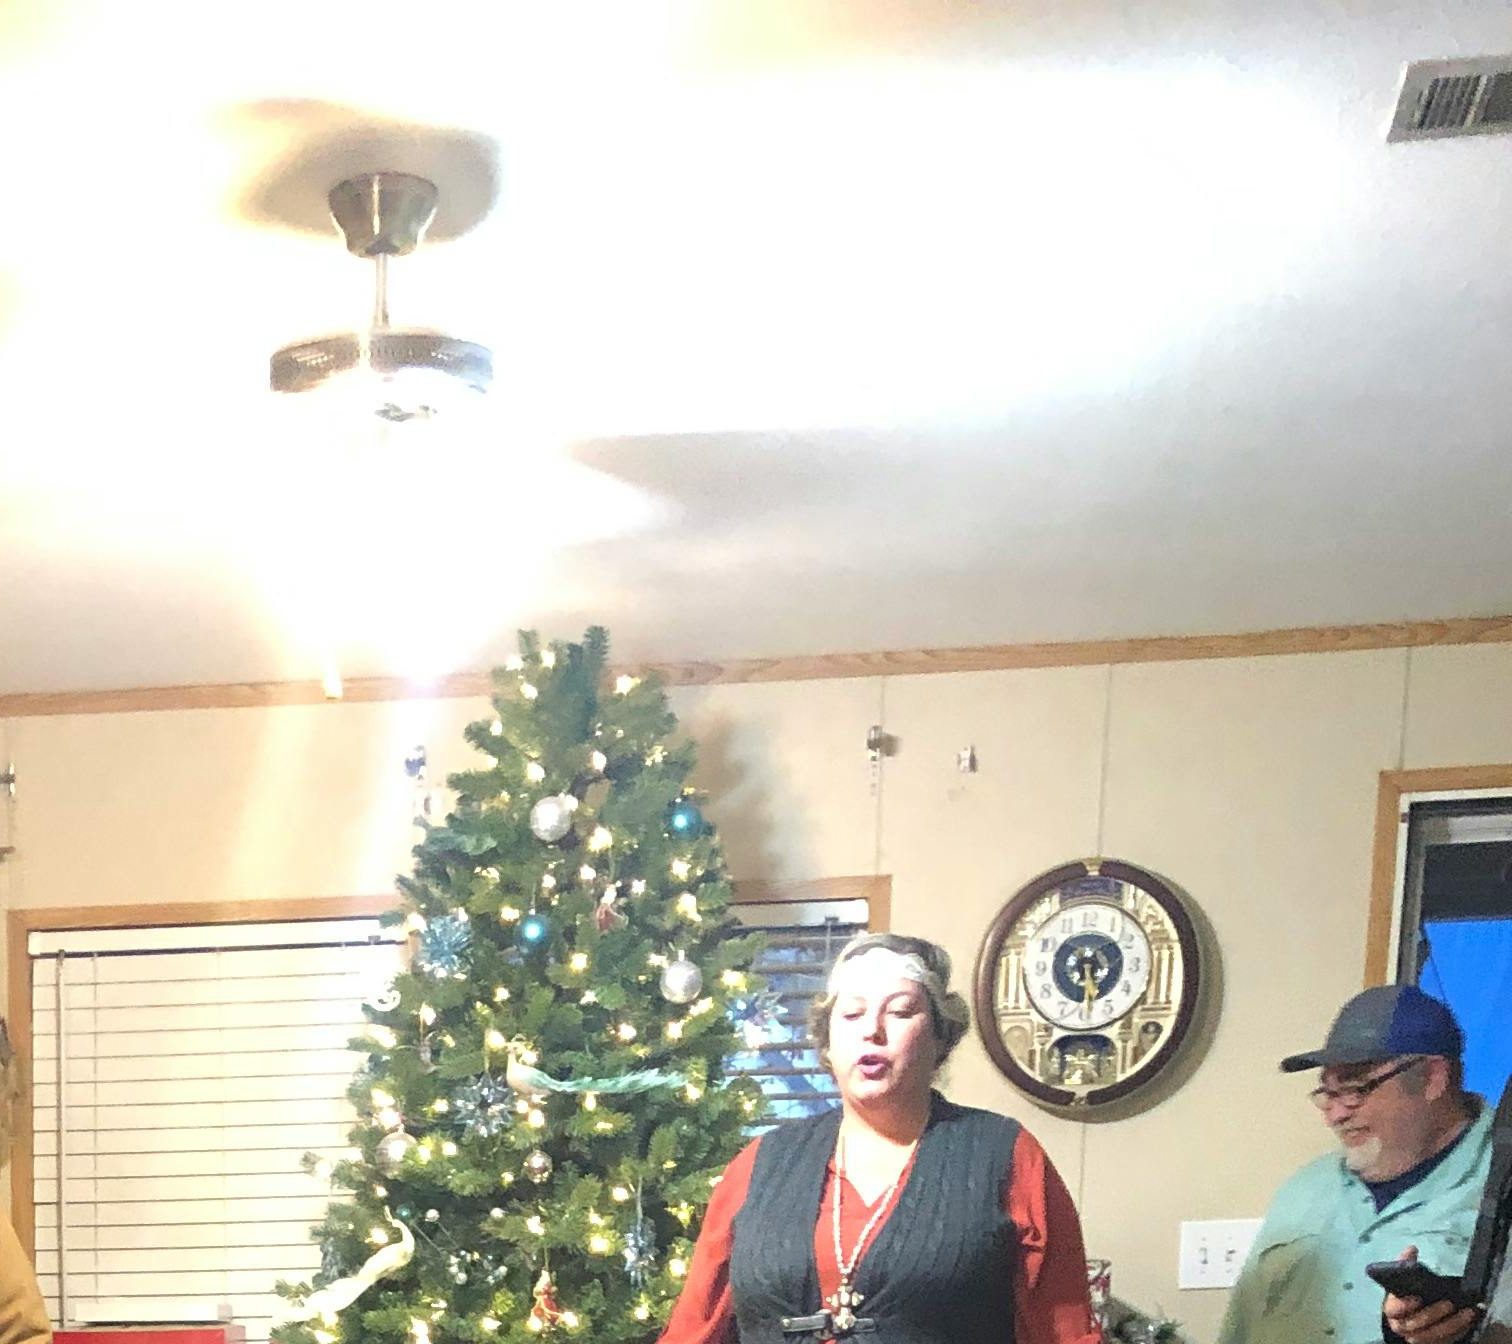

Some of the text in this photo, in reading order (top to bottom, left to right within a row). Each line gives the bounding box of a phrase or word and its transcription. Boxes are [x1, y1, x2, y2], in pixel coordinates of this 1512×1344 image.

[1062, 918, 1073, 933] 11
[1082, 911, 1098, 927] 12
[1110, 917, 1117, 932] 1
[1035, 961, 1047, 976] 9
[1128, 957, 1141, 973] 3
[1040, 983, 1052, 999] 8
[1121, 979, 1131, 996] 4
[1057, 1001, 1068, 1016] 7
[1101, 1000, 1114, 1015] 5
